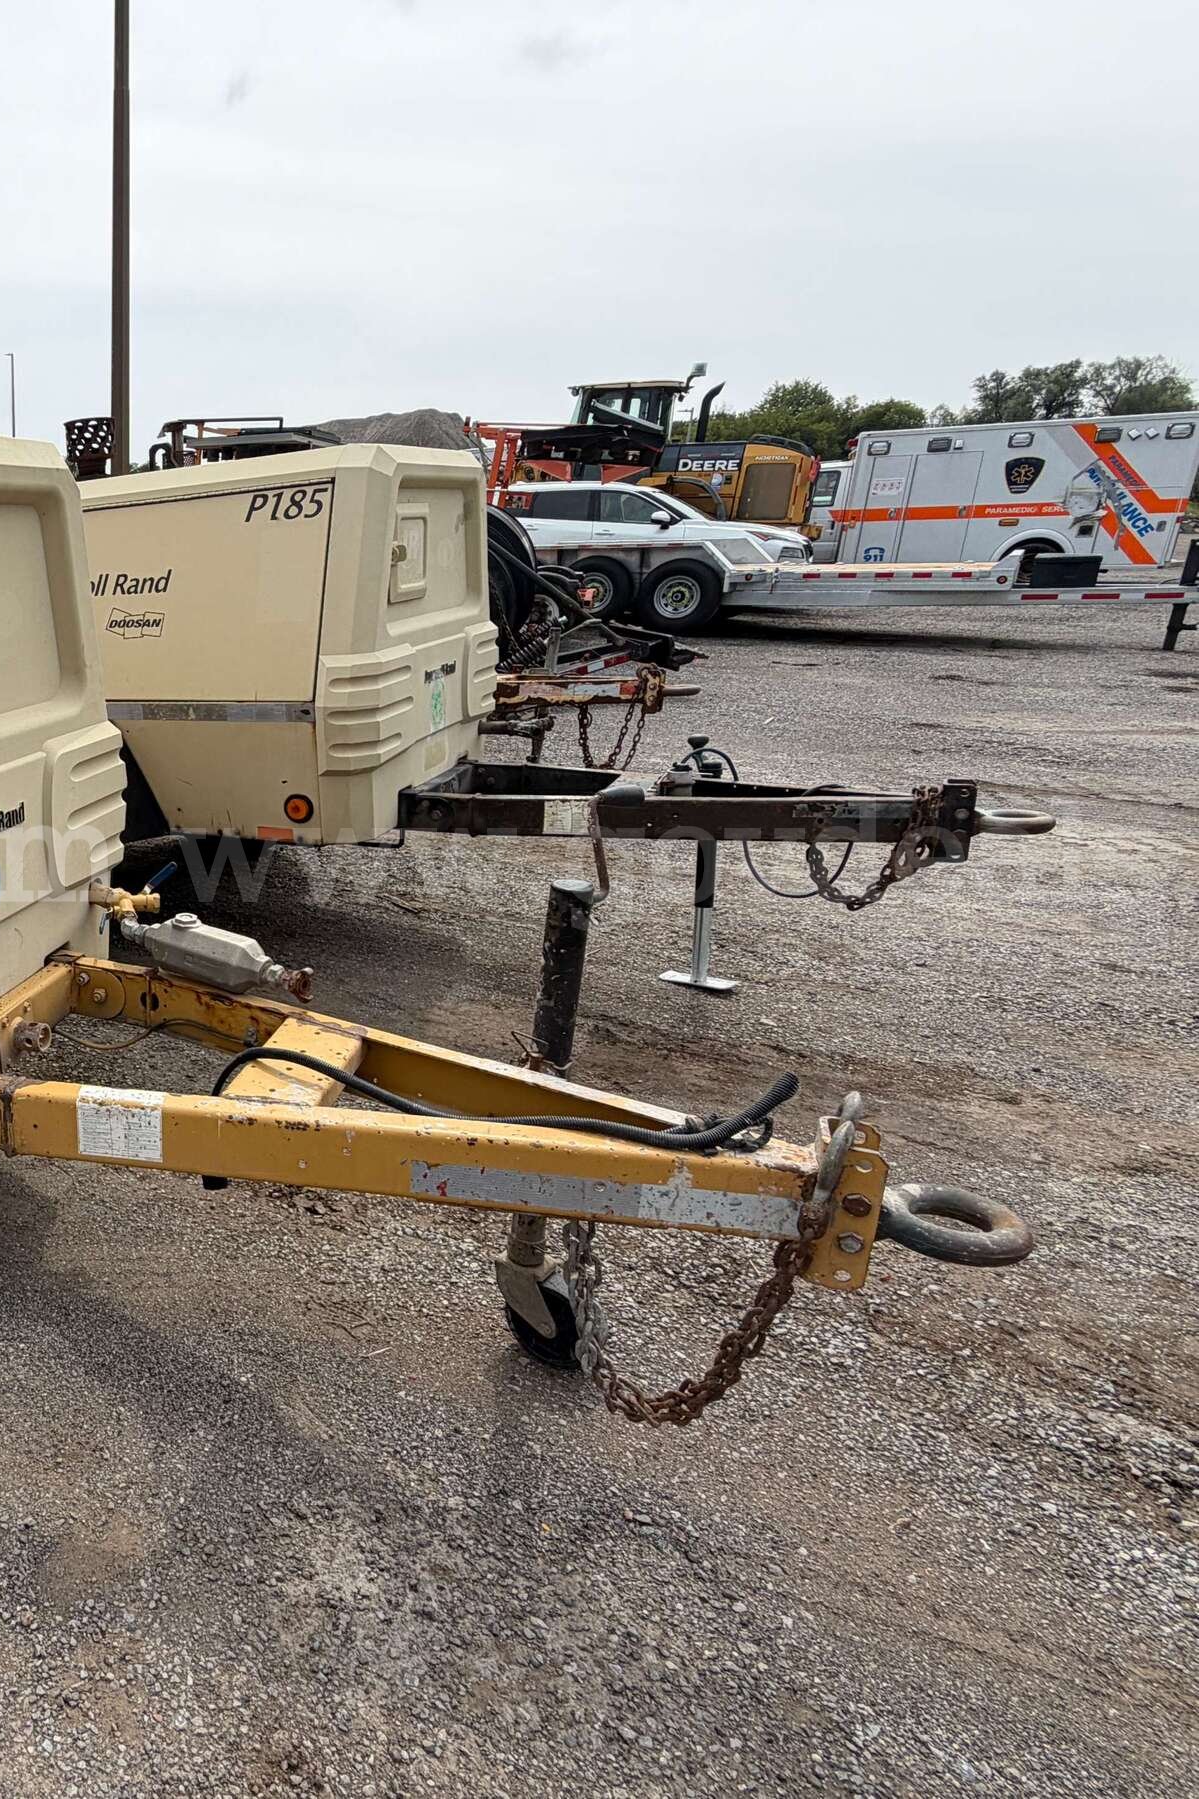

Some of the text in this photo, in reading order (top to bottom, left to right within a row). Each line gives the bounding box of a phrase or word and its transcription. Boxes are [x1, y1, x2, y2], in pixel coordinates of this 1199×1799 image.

[678, 458, 740, 471] DEERE
[245, 488, 328, 523] P185
[863, 554, 884, 562] 911
[112, 569, 172, 595] Rand
[108, 618, 161, 629] DOOSAN
